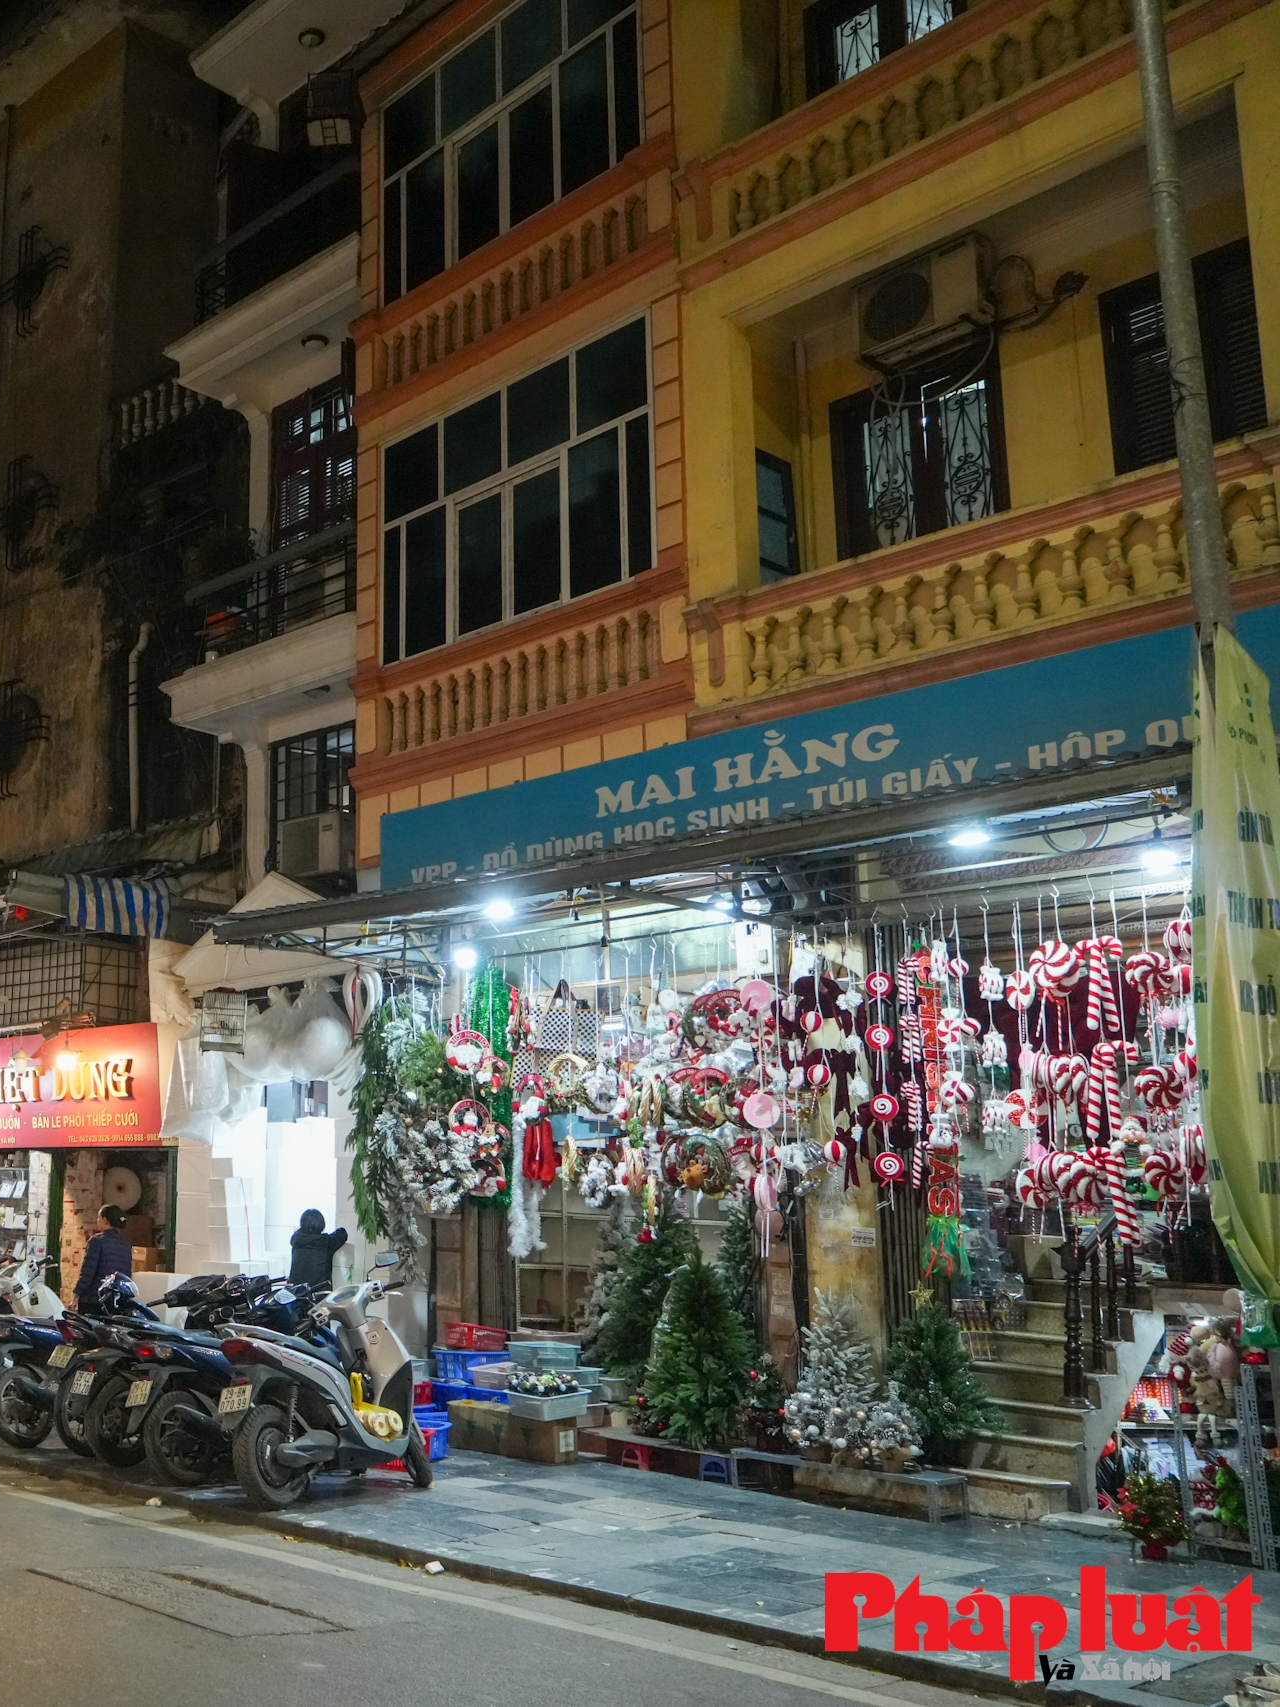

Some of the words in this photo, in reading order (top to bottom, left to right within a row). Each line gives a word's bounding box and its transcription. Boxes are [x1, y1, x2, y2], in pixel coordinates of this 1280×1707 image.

[411, 861, 457, 884] VPP
[687, 797, 770, 832] SINH
[807, 776, 867, 810] TÚI
[881, 752, 979, 796] GIẤY
[594, 765, 697, 818] MAI
[712, 723, 900, 793] HẰNG
[32, 1113, 49, 1129] BÁN
[51, 1112, 61, 1128] LẺ
[63, 1113, 85, 1128] PHÔI
[87, 1108, 112, 1126] THIẾP
[114, 1107, 139, 1126] CƯỚI
